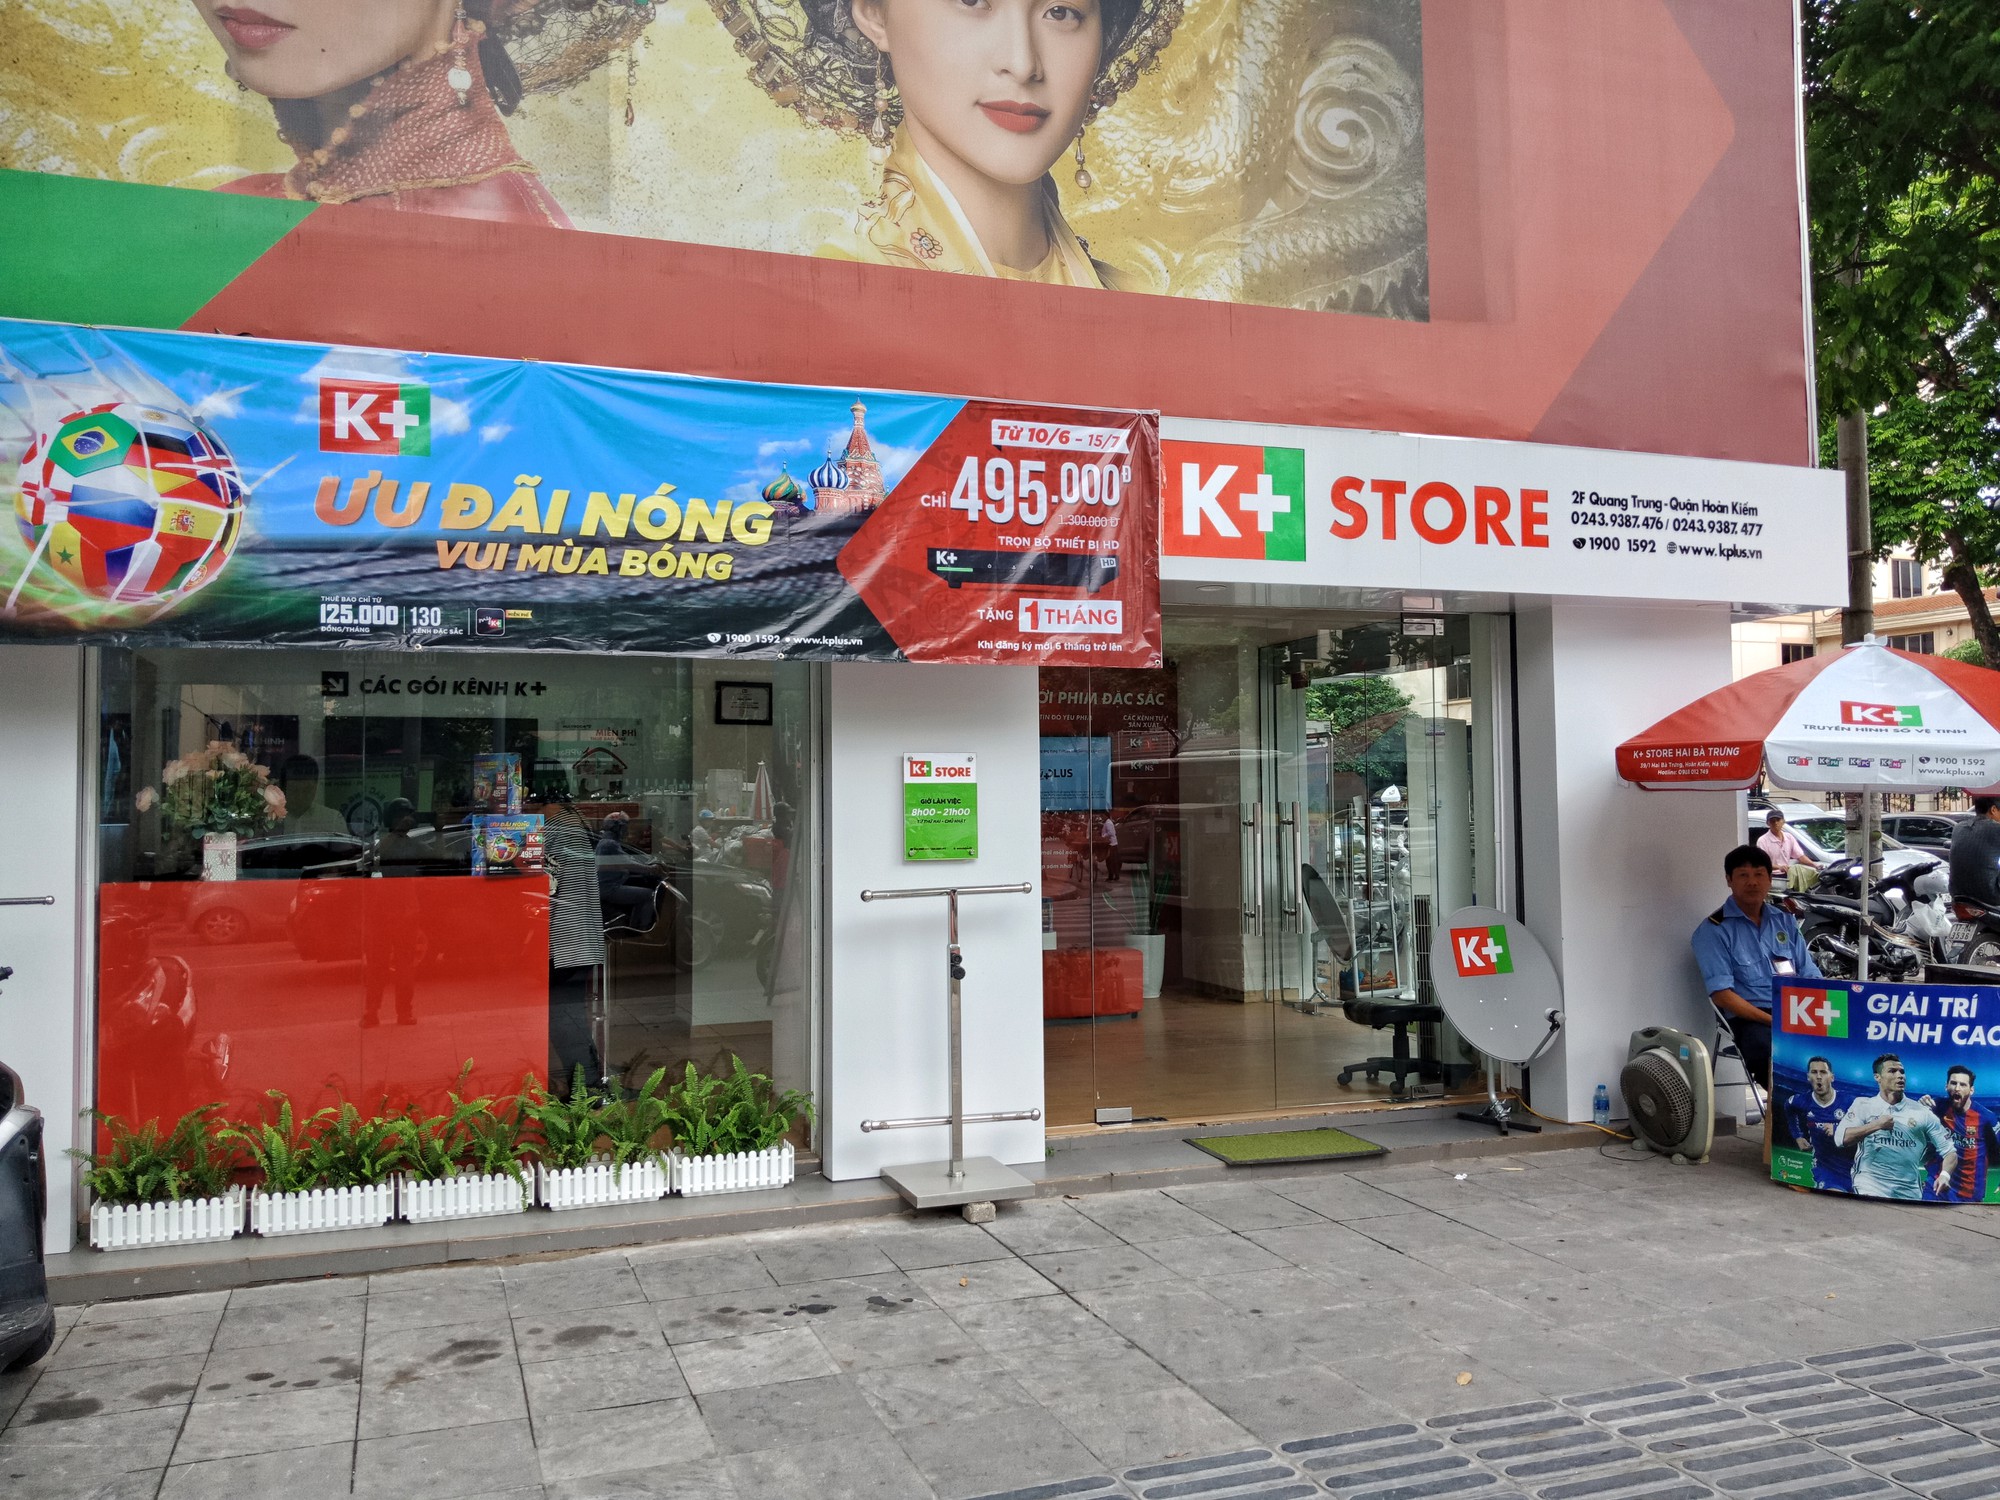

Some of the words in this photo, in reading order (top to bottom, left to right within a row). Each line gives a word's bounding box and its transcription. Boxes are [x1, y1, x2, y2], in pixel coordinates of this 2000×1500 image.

[334, 392, 420, 441] K+
[1028, 427, 1070, 446] 10/6
[1088, 434, 1121, 450] 15/7
[314, 470, 431, 528] ƯU
[440, 474, 570, 535] ĐÃI
[579, 483, 776, 546] NÓNG
[921, 491, 947, 508] CHỈ
[1182, 462, 1291, 538] K+
[1329, 476, 1550, 548] STORE
[1571, 490, 1586, 504] 2F
[1589, 492, 1629, 511] Quang
[1702, 499, 1729, 514] Hoàn
[1731, 501, 1758, 516] Kiếm
[1571, 511, 1664, 531] 0243.9387.476
[1672, 518, 1763, 536] 0243.9387.477
[998, 536, 1031, 549] TRỌN
[1034, 536, 1052, 548] BỘ
[1054, 536, 1086, 549] THIẾT
[1103, 540, 1120, 550] HD
[1589, 536, 1620, 551] 1900
[1627, 538, 1656, 553] 1592
[1679, 543, 1763, 561] www.kplus.vn
[435, 540, 510, 571] VUI
[515, 538, 609, 575] MÙA
[618, 540, 734, 580] BÓNG
[936, 550, 958, 564] K+
[1102, 558, 1115, 567] HD
[320, 604, 399, 625] 125.000
[410, 606, 441, 627] 130
[977, 608, 1014, 624] TẶNG
[1024, 601, 1040, 630] 1
[1044, 604, 1119, 625] THÁNG
[412, 627, 432, 635] KÊNH
[725, 633, 751, 643] 1900
[755, 634, 781, 644] 1592
[793, 635, 863, 647] www.kplus.vn
[977, 640, 994, 649] Khi
[995, 641, 1019, 652] đăng
[1064, 641, 1091, 653] tháng
[1109, 642, 1123, 652] lên
[359, 674, 401, 695] CÁC
[407, 675, 447, 696] GÓI
[452, 677, 509, 696] KÊNH
[514, 681, 547, 697] K+
[1058, 692, 1097, 705] PHIM
[1102, 690, 1134, 708] ĐẶC
[1851, 705, 1913, 723] K+
[1633, 750, 1643, 759] K+
[1646, 748, 1674, 758] STORE
[1676, 748, 1691, 757] HAI
[1693, 746, 1706, 757] BÀ
[1708, 746, 1740, 756] TRƯNG
[1934, 756, 1958, 765] 1900
[1962, 757, 1985, 766] 1592
[913, 763, 930, 775] K+
[935, 766, 971, 778] STORE
[1918, 767, 1985, 777] www.kplus.vn
[911, 808, 936, 816] 8h00
[943, 808, 971, 816] 21h00
[1458, 936, 1503, 968] K+
[1789, 995, 1840, 1027] K+
[1867, 991, 1927, 1017] GIẢI
[1938, 993, 1979, 1018] TRÍ
[1866, 1017, 1942, 1045] ĐỈNH
[1873, 1134, 1917, 1148] Emirates
